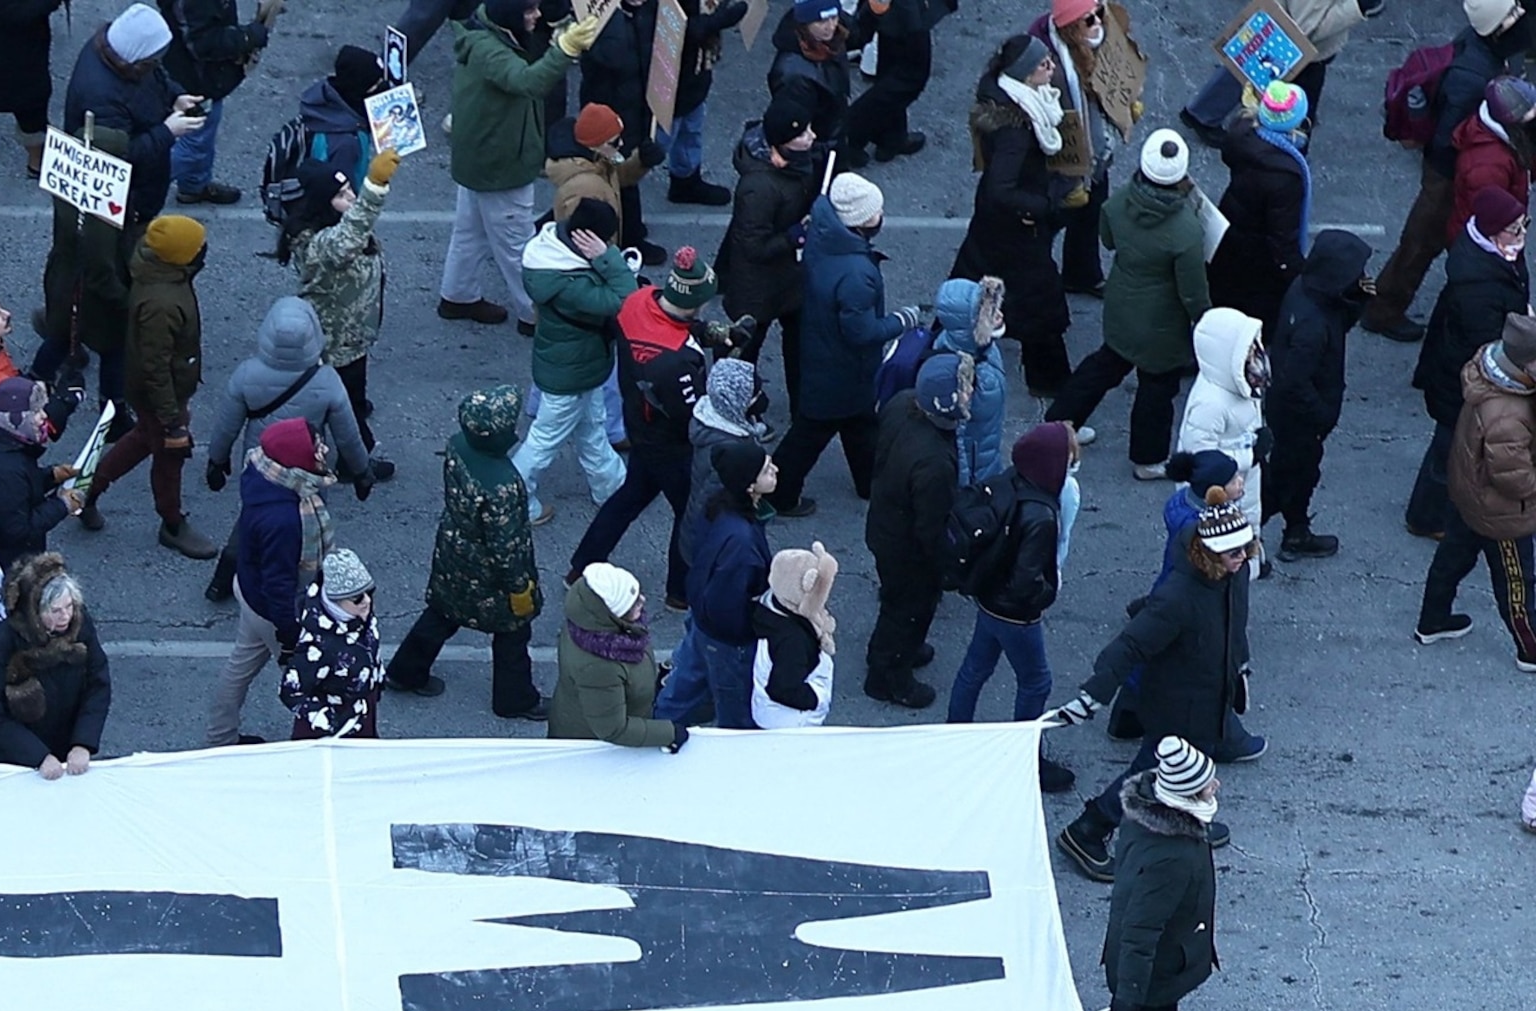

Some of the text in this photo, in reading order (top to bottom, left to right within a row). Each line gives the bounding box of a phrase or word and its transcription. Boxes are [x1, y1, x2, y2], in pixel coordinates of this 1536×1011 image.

[48, 134, 128, 183] IMMIGRANTS
[51, 157, 114, 198] MAKE US
[46, 171, 103, 211] GREAT
[678, 373, 697, 404] FLY
